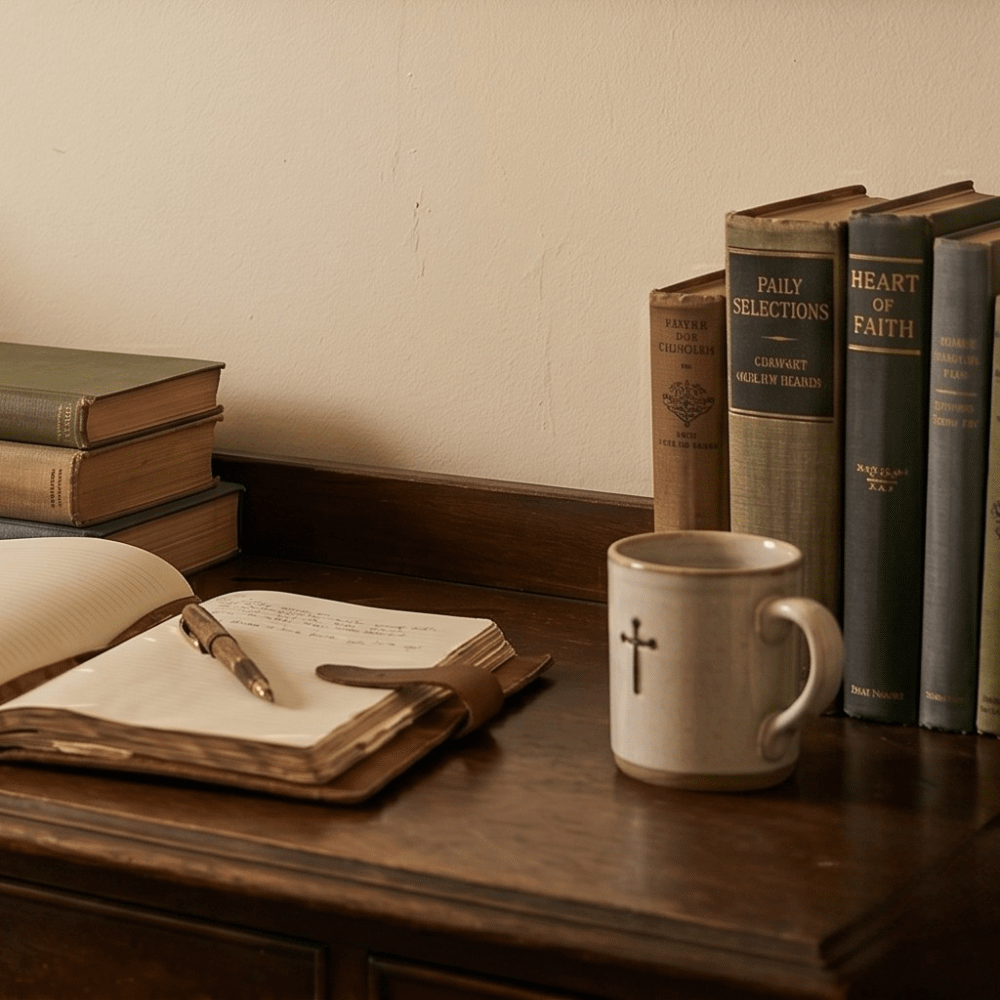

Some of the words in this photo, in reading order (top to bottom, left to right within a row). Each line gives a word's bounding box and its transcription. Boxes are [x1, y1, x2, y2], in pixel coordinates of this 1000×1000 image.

[757, 276, 803, 295] PAILY
[851, 269, 920, 293] HEART
[732, 297, 829, 321] SELECTIONS
[872, 297, 894, 312] OF
[854, 315, 914, 338] FAITH
